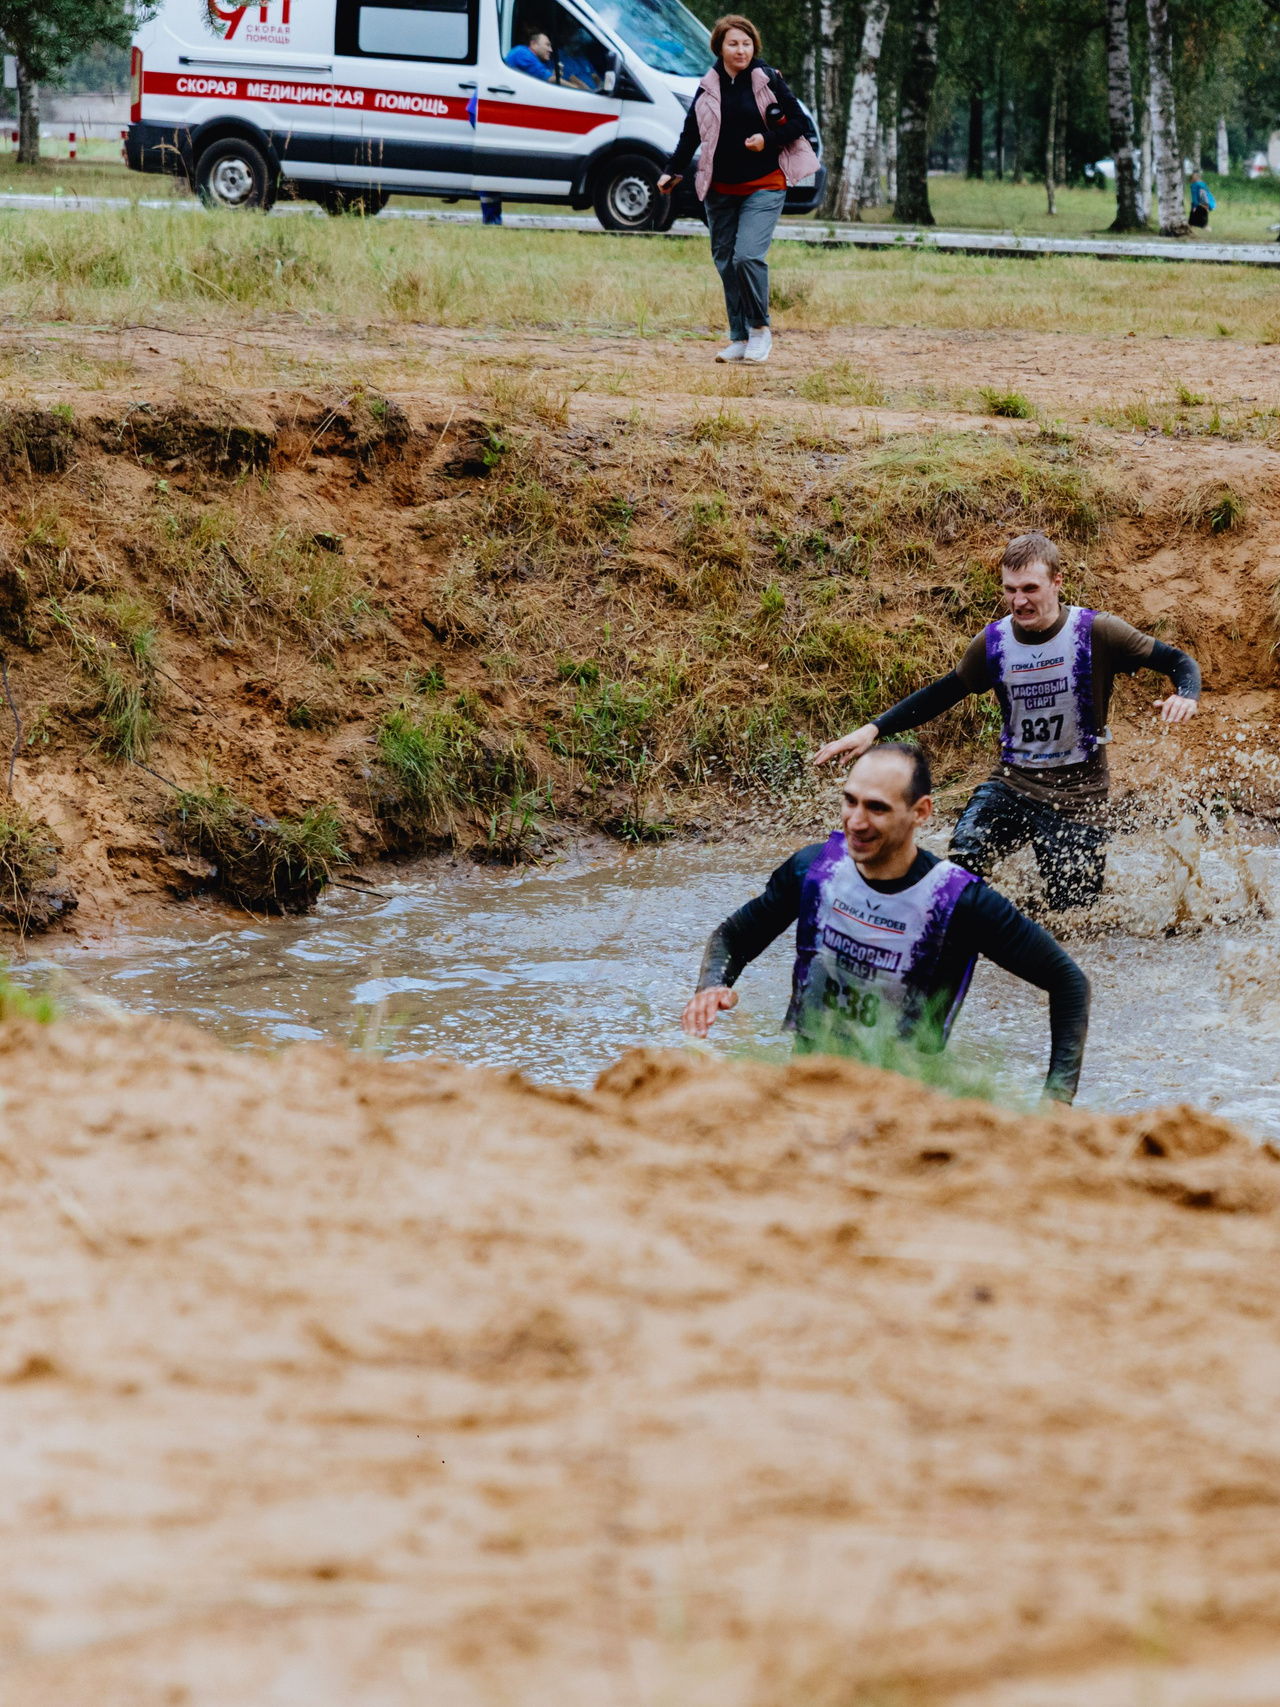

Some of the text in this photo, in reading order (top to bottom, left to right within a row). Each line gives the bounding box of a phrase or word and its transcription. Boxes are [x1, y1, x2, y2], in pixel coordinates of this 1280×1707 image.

[246, 25, 290, 34] СКОРАЯ
[246, 34, 290, 44] ПОМОЩЬ
[176, 77, 449, 116] СКОРАЯ МЕДИЦИНСКАЯ ПОМОЩЬ
[1012, 656, 1065, 671] ГОНКА ГЕРОЕВ
[1013, 676, 1067, 700] МАССОВЫЙ
[1026, 695, 1054, 709] СТАРТ
[1021, 714, 1064, 743] 837
[832, 898, 907, 931] ГОНКА ГЕРОЕВ
[824, 929, 901, 970] МАССОВЫЙ
[838, 955, 876, 981] СТАРТ
[823, 977, 880, 1028] 838
